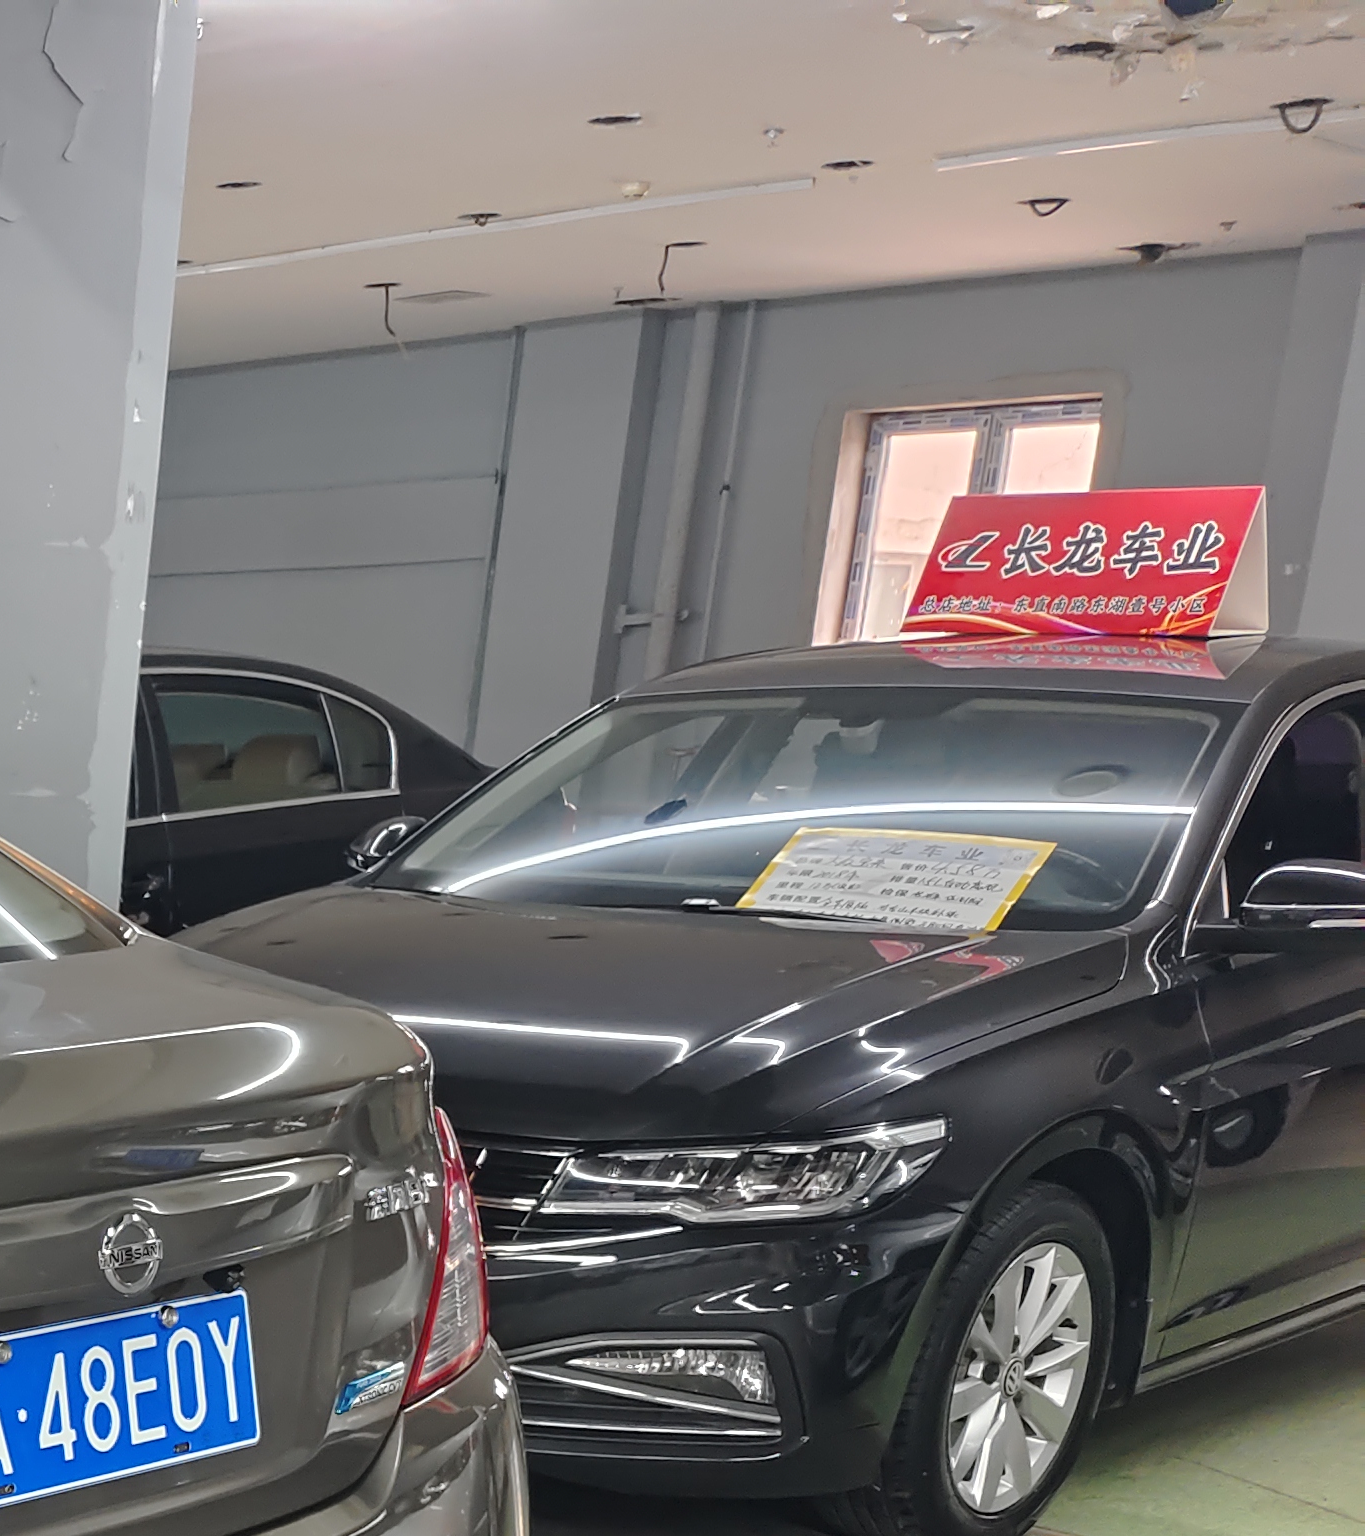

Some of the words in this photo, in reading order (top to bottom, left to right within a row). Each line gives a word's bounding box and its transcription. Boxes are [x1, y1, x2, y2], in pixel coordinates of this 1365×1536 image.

[1001, 520, 1225, 579] 长龙车业
[109, 1245, 158, 1267] NISSAN
